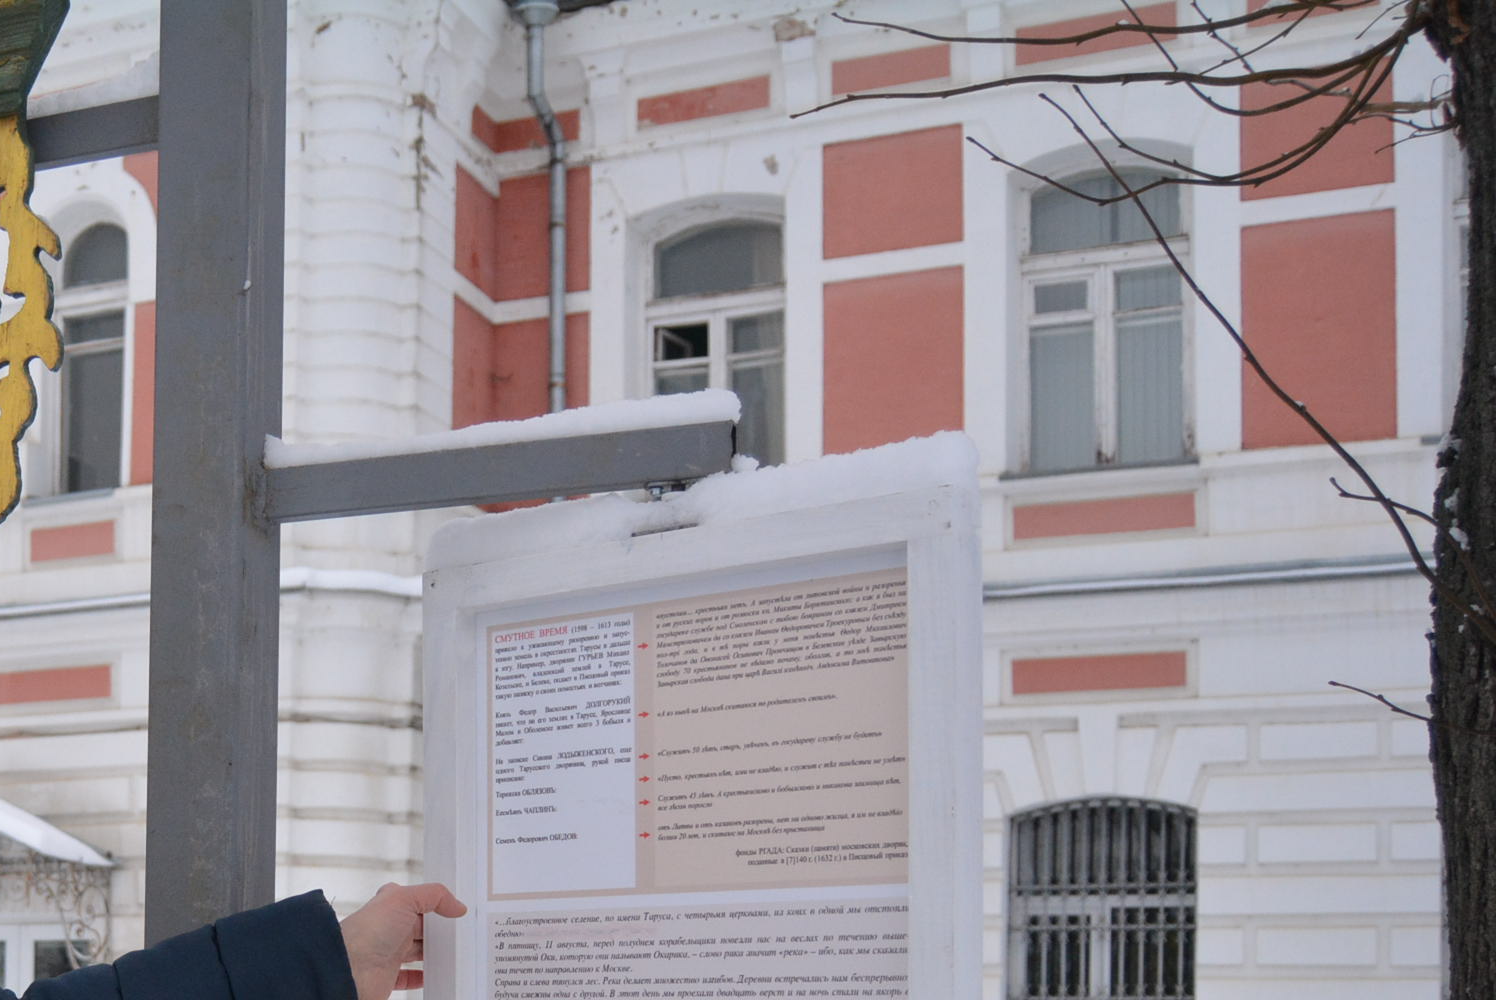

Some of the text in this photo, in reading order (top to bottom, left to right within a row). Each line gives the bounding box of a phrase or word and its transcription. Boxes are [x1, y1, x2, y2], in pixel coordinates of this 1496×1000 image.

[494, 630, 535, 643] СМУТНОЕ
[539, 625, 567, 637] ВРЕМЯ
[585, 695, 631, 709] ДОЛГОРУКИЙ
[643, 911, 673, 922] Таруса,
[684, 912, 726, 920] четырьмя
[729, 911, 770, 920] церквами,
[818, 905, 844, 915] одной
[556, 942, 589, 950] августа,
[593, 939, 615, 949] перед
[602, 964, 632, 973] Москве.
